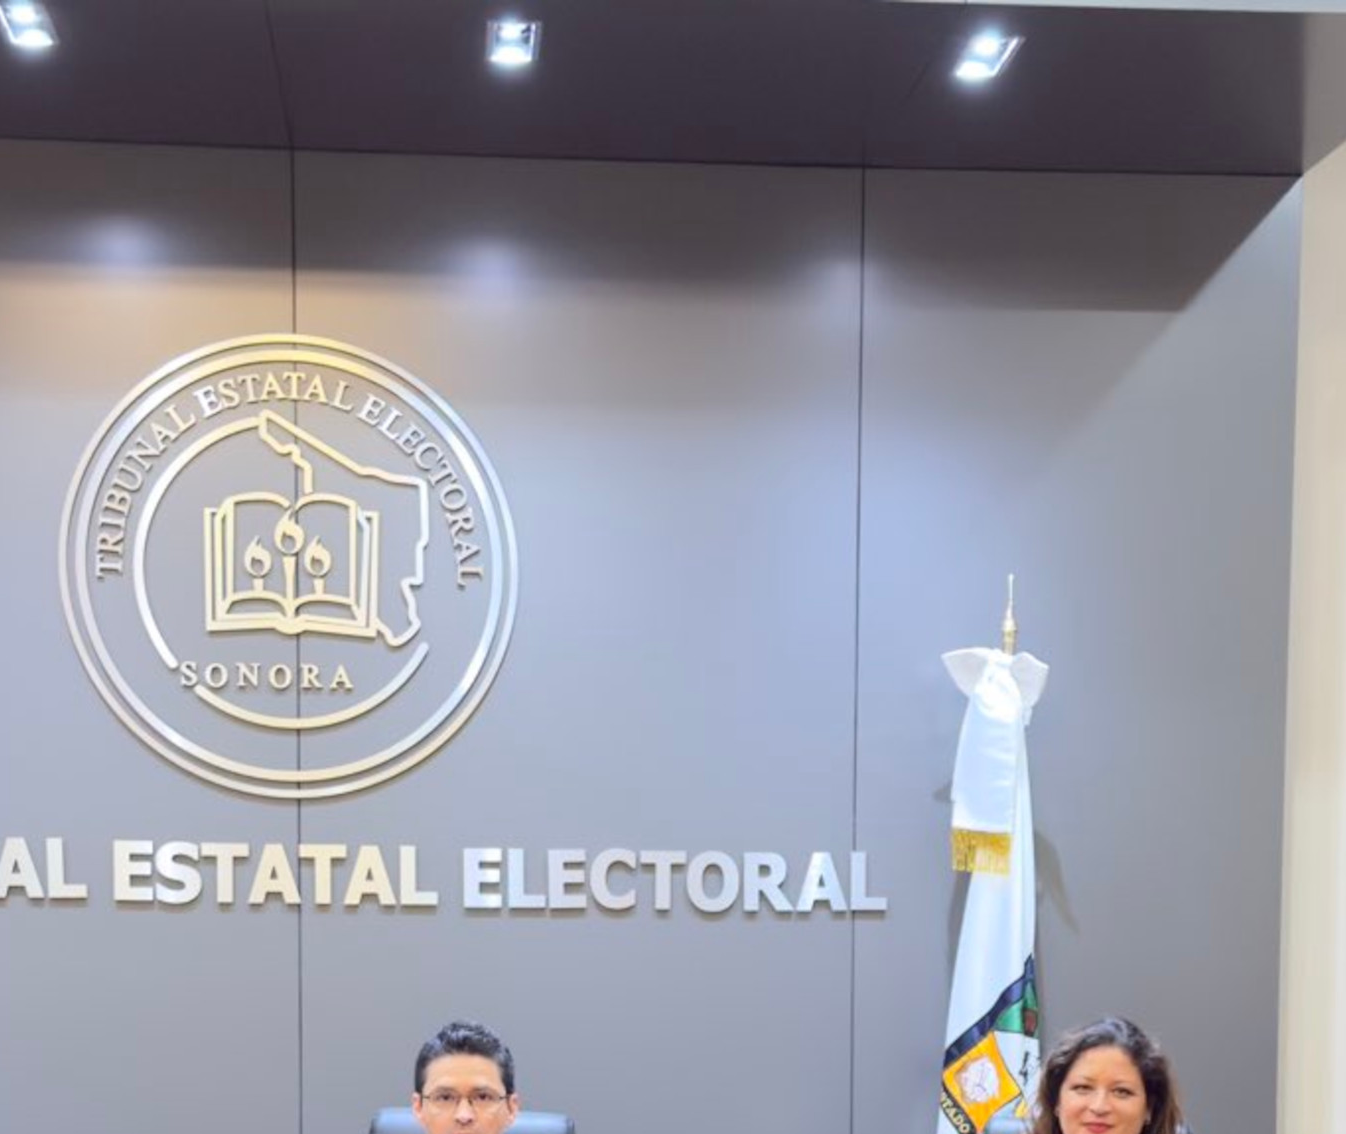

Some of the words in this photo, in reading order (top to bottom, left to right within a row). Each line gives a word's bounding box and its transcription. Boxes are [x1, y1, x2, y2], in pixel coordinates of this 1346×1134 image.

[95, 402, 196, 580] TRIBUNAL
[192, 371, 354, 420] ESTATAL
[356, 393, 484, 589] ELECTORAL
[180, 660, 354, 691] SONORA
[112, 840, 439, 905] ESTATAL
[463, 847, 888, 914] ELECTORAL
